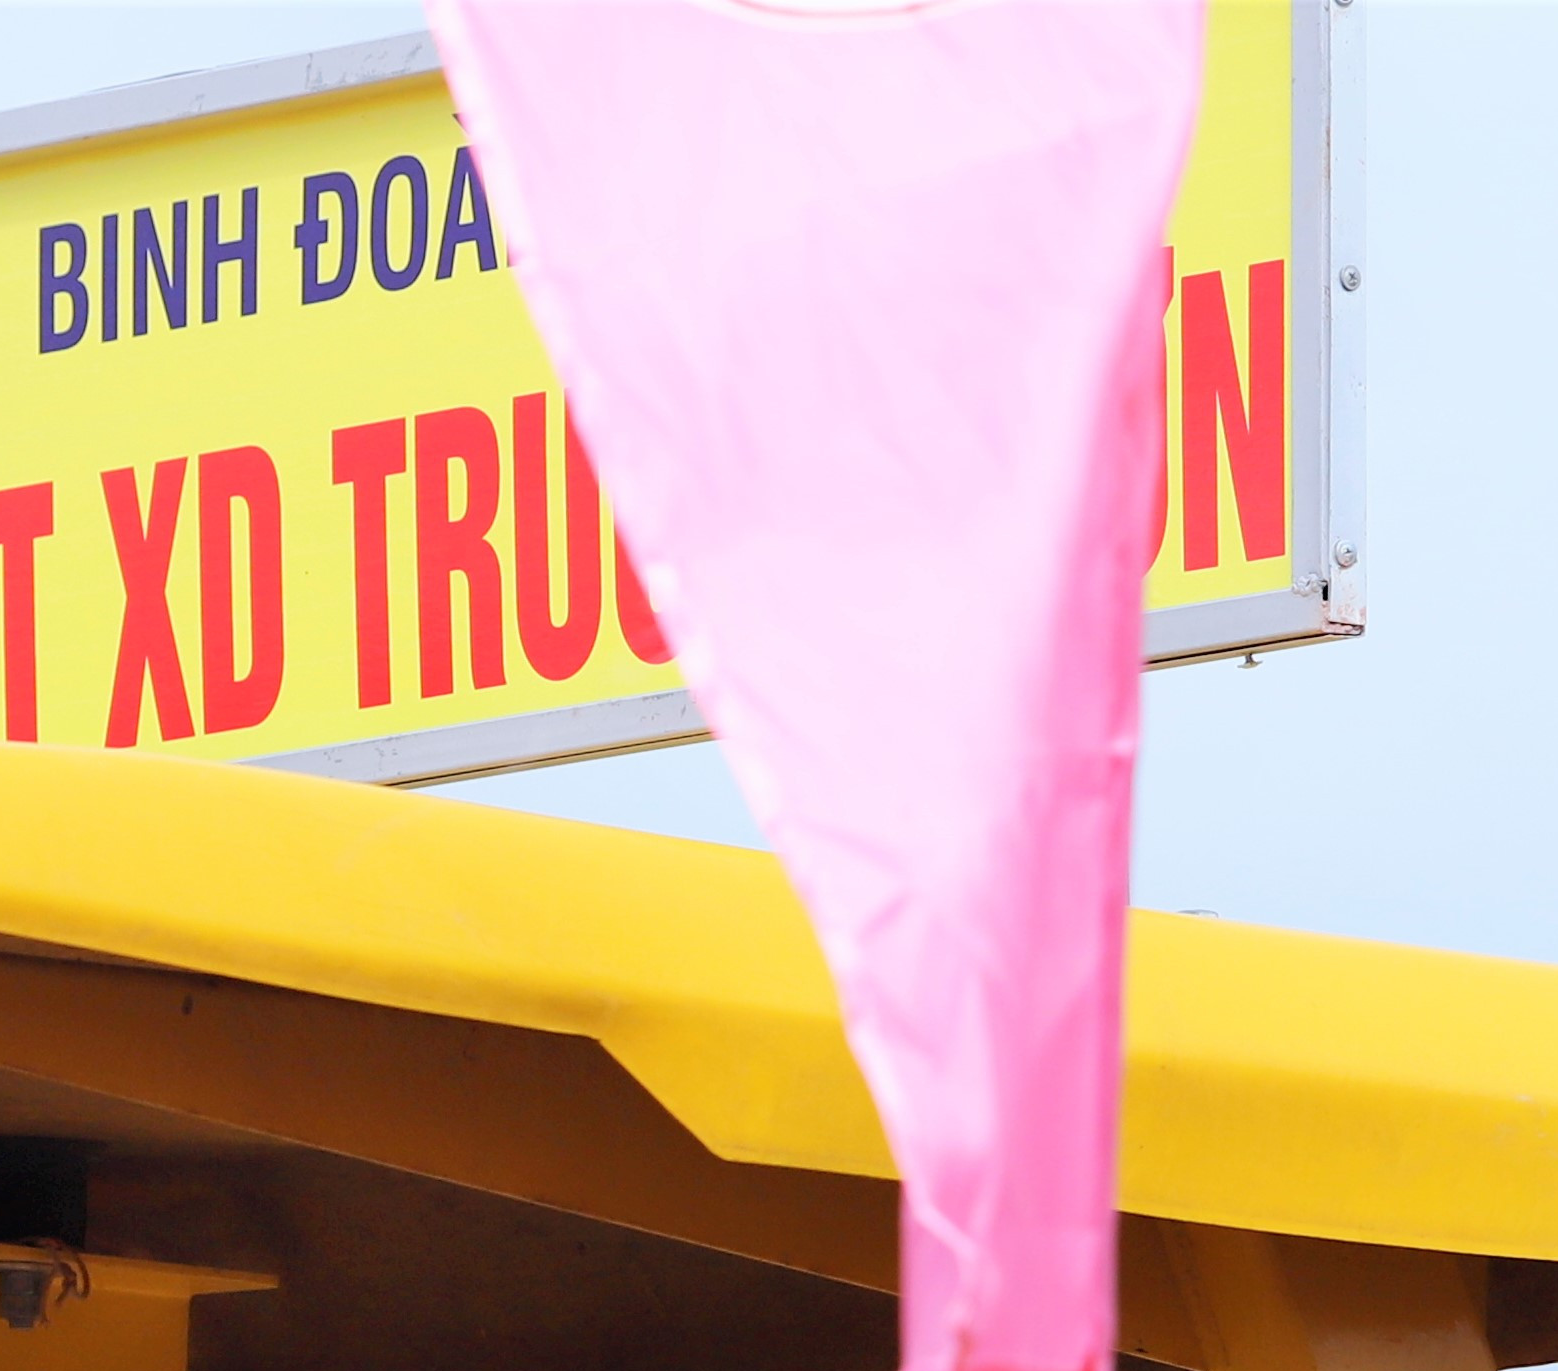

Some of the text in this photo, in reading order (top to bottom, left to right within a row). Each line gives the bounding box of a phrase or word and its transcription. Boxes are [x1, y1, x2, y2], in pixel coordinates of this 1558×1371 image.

[39, 112, 520, 355] BINH ĐOÀ
[100, 445, 285, 749] XD
